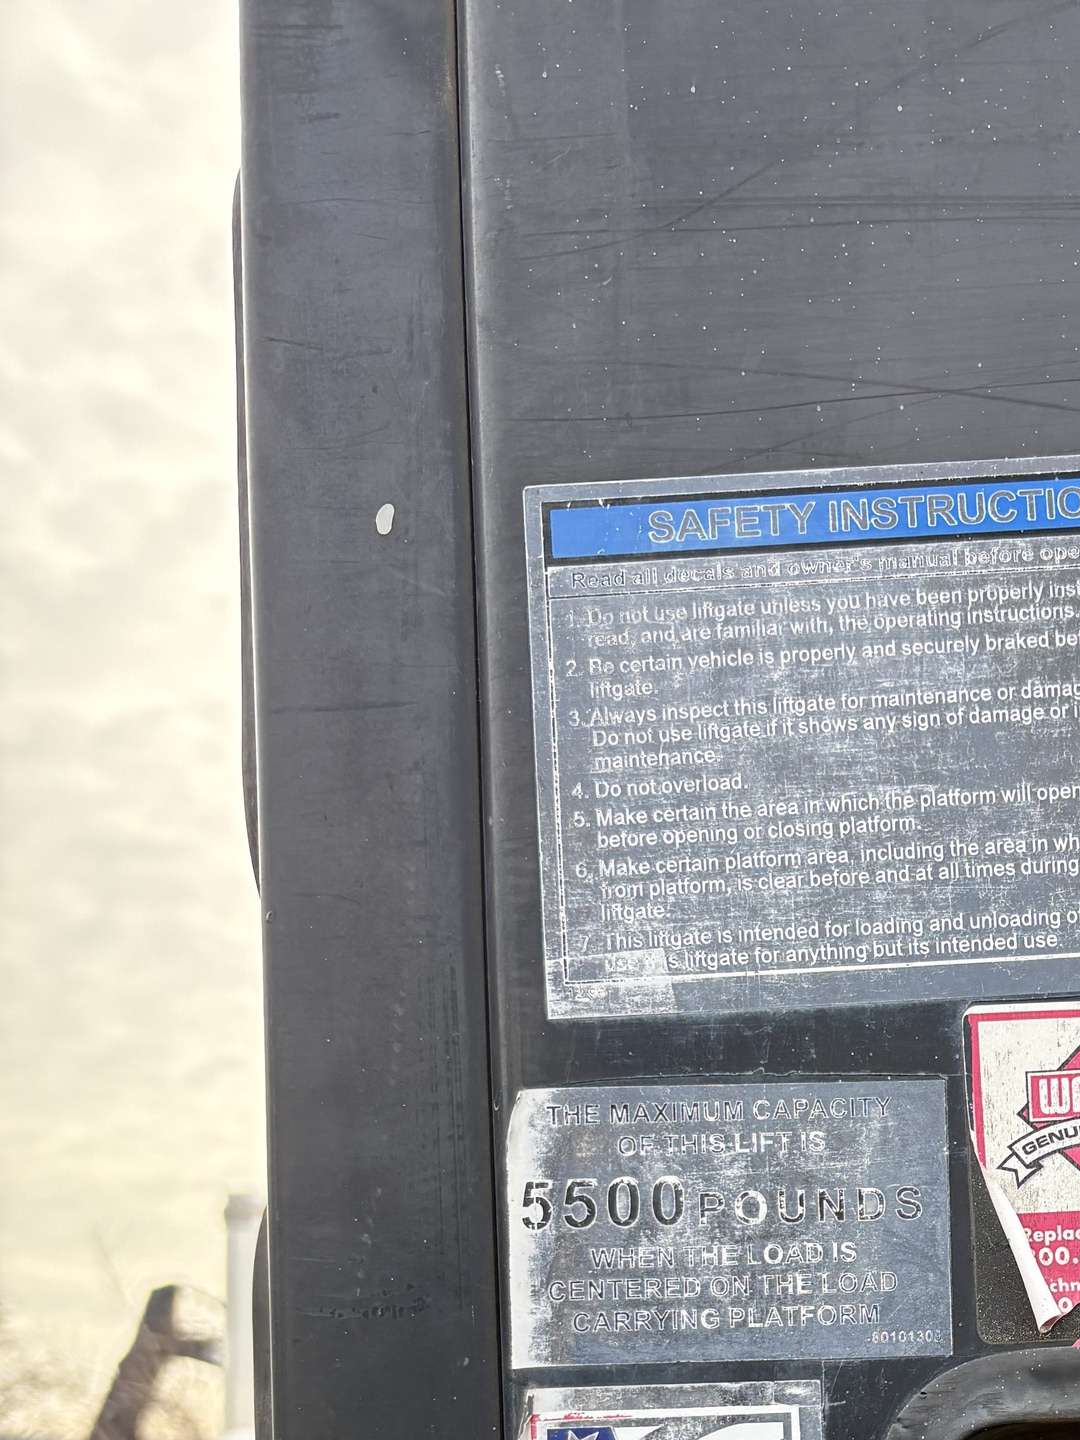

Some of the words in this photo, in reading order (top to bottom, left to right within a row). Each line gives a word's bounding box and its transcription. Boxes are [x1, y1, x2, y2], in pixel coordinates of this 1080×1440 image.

[647, 500, 817, 544] SAFETY
[571, 570, 625, 588] Read
[631, 568, 657, 585] all
[663, 563, 734, 583] decals
[741, 560, 781, 578] and
[787, 555, 871, 575] owner's
[878, 549, 957, 570] manual
[964, 545, 1033, 565] before
[589, 657, 614, 675] Be
[619, 653, 682, 673] certain
[687, 649, 754, 669] vehicle
[759, 648, 774, 664] is
[779, 643, 855, 668] properly
[861, 640, 895, 658] and
[901, 635, 979, 659] securely
[985, 631, 1048, 651] braked
[568, 709, 587, 727] 3.
[590, 705, 656, 728] Always
[662, 701, 729, 724] inspect
[734, 698, 767, 716] this
[772, 694, 836, 718] liftgate
[840, 692, 866, 710] for
[871, 685, 992, 708] maintenance
[997, 687, 1015, 700] or
[571, 782, 589, 800] 4.
[595, 780, 621, 798] Do
[627, 779, 656, 796] not
[661, 773, 749, 794] overload.
[573, 810, 590, 828] 5.
[596, 807, 647, 826] Make
[652, 803, 716, 823] certain
[722, 801, 751, 819] the
[757, 801, 798, 817] area
[804, 797, 820, 814] in
[825, 793, 879, 813] which
[884, 791, 914, 810] the
[919, 787, 996, 811] platform
[1000, 785, 1030, 803] will
[597, 829, 657, 848] before
[662, 825, 738, 848] opening
[744, 826, 762, 840] or
[767, 819, 833, 842] closing
[839, 814, 922, 838] platform.
[598, 857, 649, 877] Make
[655, 853, 718, 873] certain
[724, 849, 801, 873] platform
[807, 849, 853, 868] area,
[860, 840, 944, 864] including
[949, 838, 979, 856] the
[984, 839, 1026, 854] area
[1032, 834, 1048, 852] in
[600, 880, 643, 899] from
[649, 875, 732, 900] platform,
[737, 874, 752, 891] is
[757, 871, 803, 890] clear
[809, 867, 870, 887] before
[876, 865, 910, 883] and
[915, 864, 933, 881] at
[938, 862, 959, 879] all
[964, 859, 1015, 878] times
[1020, 855, 1079, 878] during
[605, 931, 642, 950] This
[648, 927, 712, 950] liftgate
[717, 926, 732, 943] is
[738, 921, 819, 942] intended
[824, 919, 850, 937] for
[855, 915, 923, 939] loading
[928, 912, 963, 931] and
[969, 907, 1061, 933] unloading
[547, 1102, 600, 1125] THE
[610, 1099, 743, 1124] MAXIMUM
[752, 1096, 892, 1121] CAPACITY
[618, 1135, 659, 1157] OF
[663, 1133, 724, 1155] THIS
[734, 1132, 790, 1154] LIFT
[801, 1131, 826, 1152] IS
[521, 1175, 684, 1231] 5500
[699, 1186, 923, 1226] POUNDS
[592, 1246, 674, 1268] WHEN
[683, 1244, 738, 1267] THE
[747, 1243, 823, 1266] LOAD
[833, 1242, 856, 1262] IS
[549, 1276, 701, 1301] CENTERED
[710, 1274, 752, 1297] ON
[762, 1273, 814, 1295] THE
[821, 1271, 898, 1294] LOAD
[574, 1308, 720, 1333] CARRYING
[728, 1304, 879, 1329] PLATFORM
